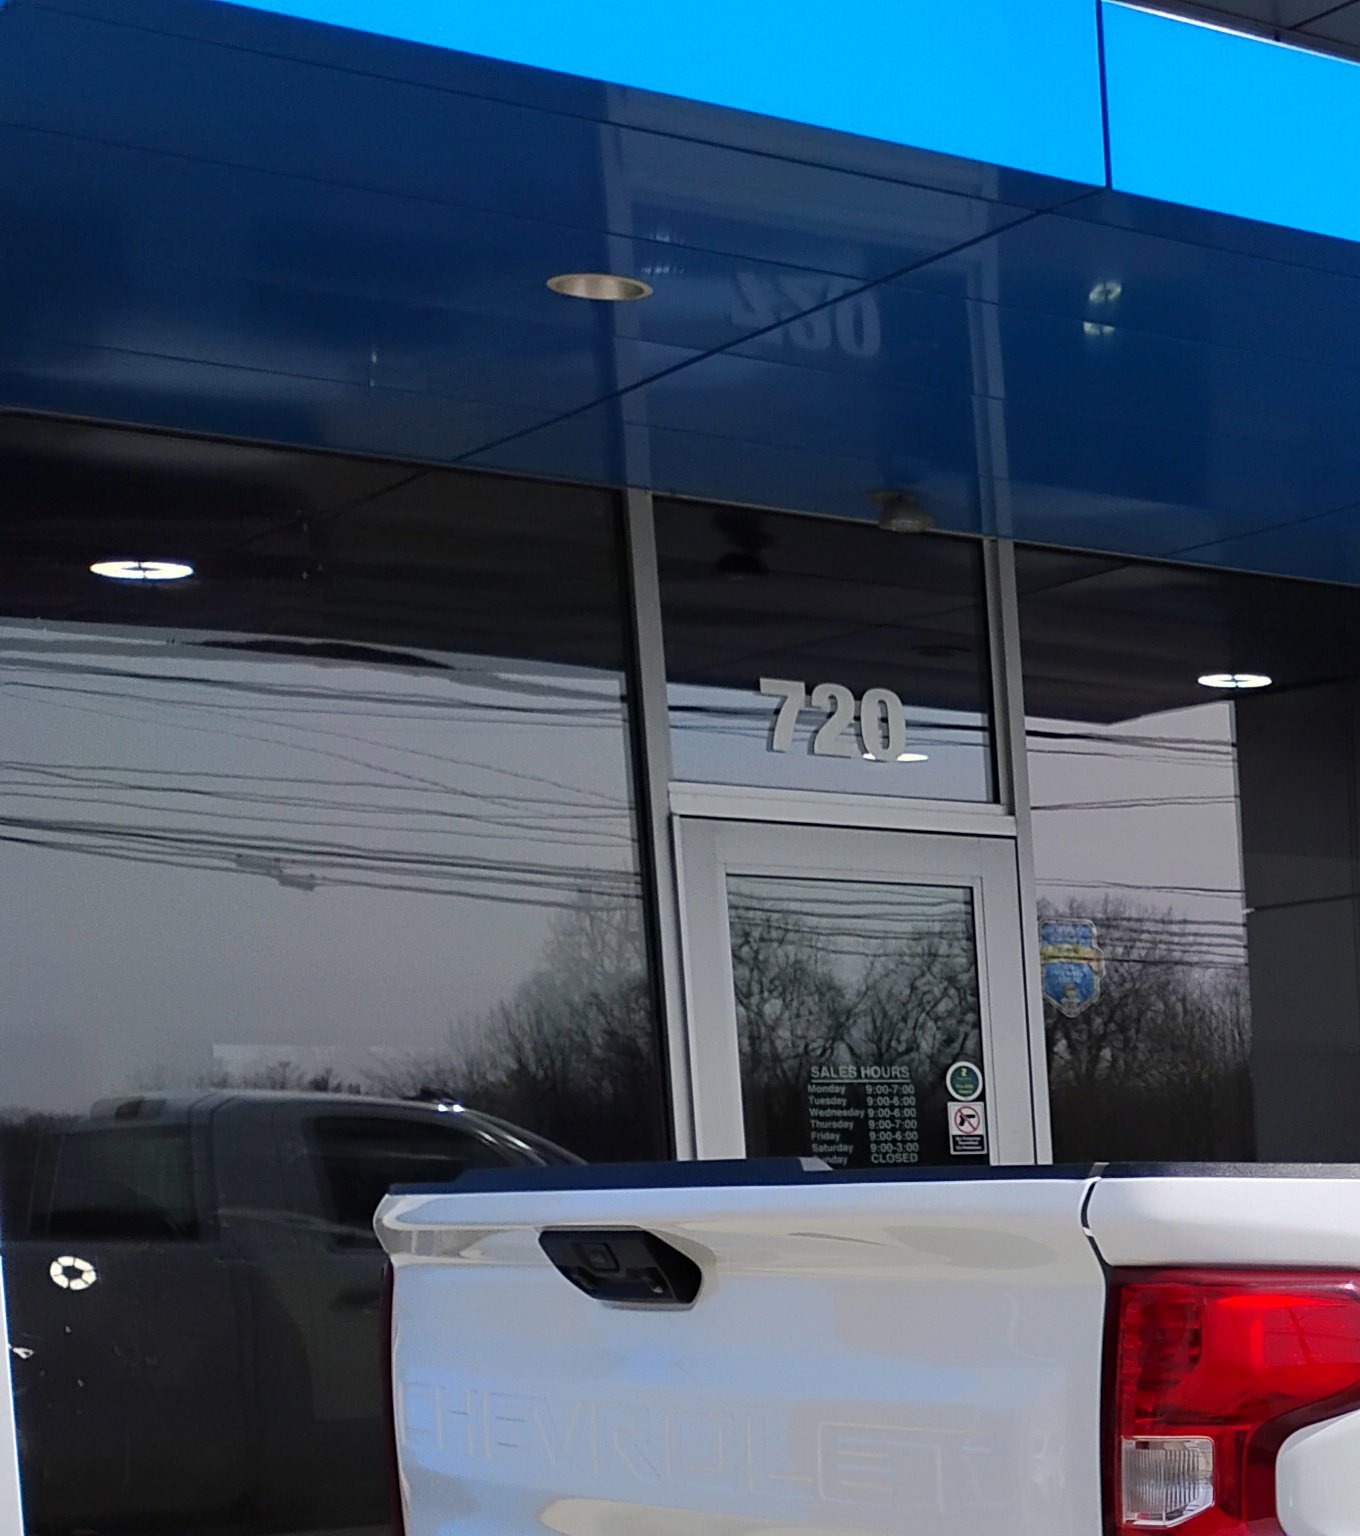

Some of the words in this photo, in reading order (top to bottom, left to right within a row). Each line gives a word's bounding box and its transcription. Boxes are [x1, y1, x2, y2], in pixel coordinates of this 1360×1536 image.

[759, 677, 906, 762] 720
[810, 1065, 857, 1078] SALES
[861, 1065, 910, 1078] HOURS
[807, 1084, 846, 1095] Monday
[808, 1096, 847, 1107] Tuesday
[809, 1107, 865, 1119] Wednesday
[810, 1119, 854, 1131] Thursday
[811, 1131, 841, 1142] Friday
[812, 1143, 854, 1155] Saturday
[871, 1153, 919, 1164] CLOSED
